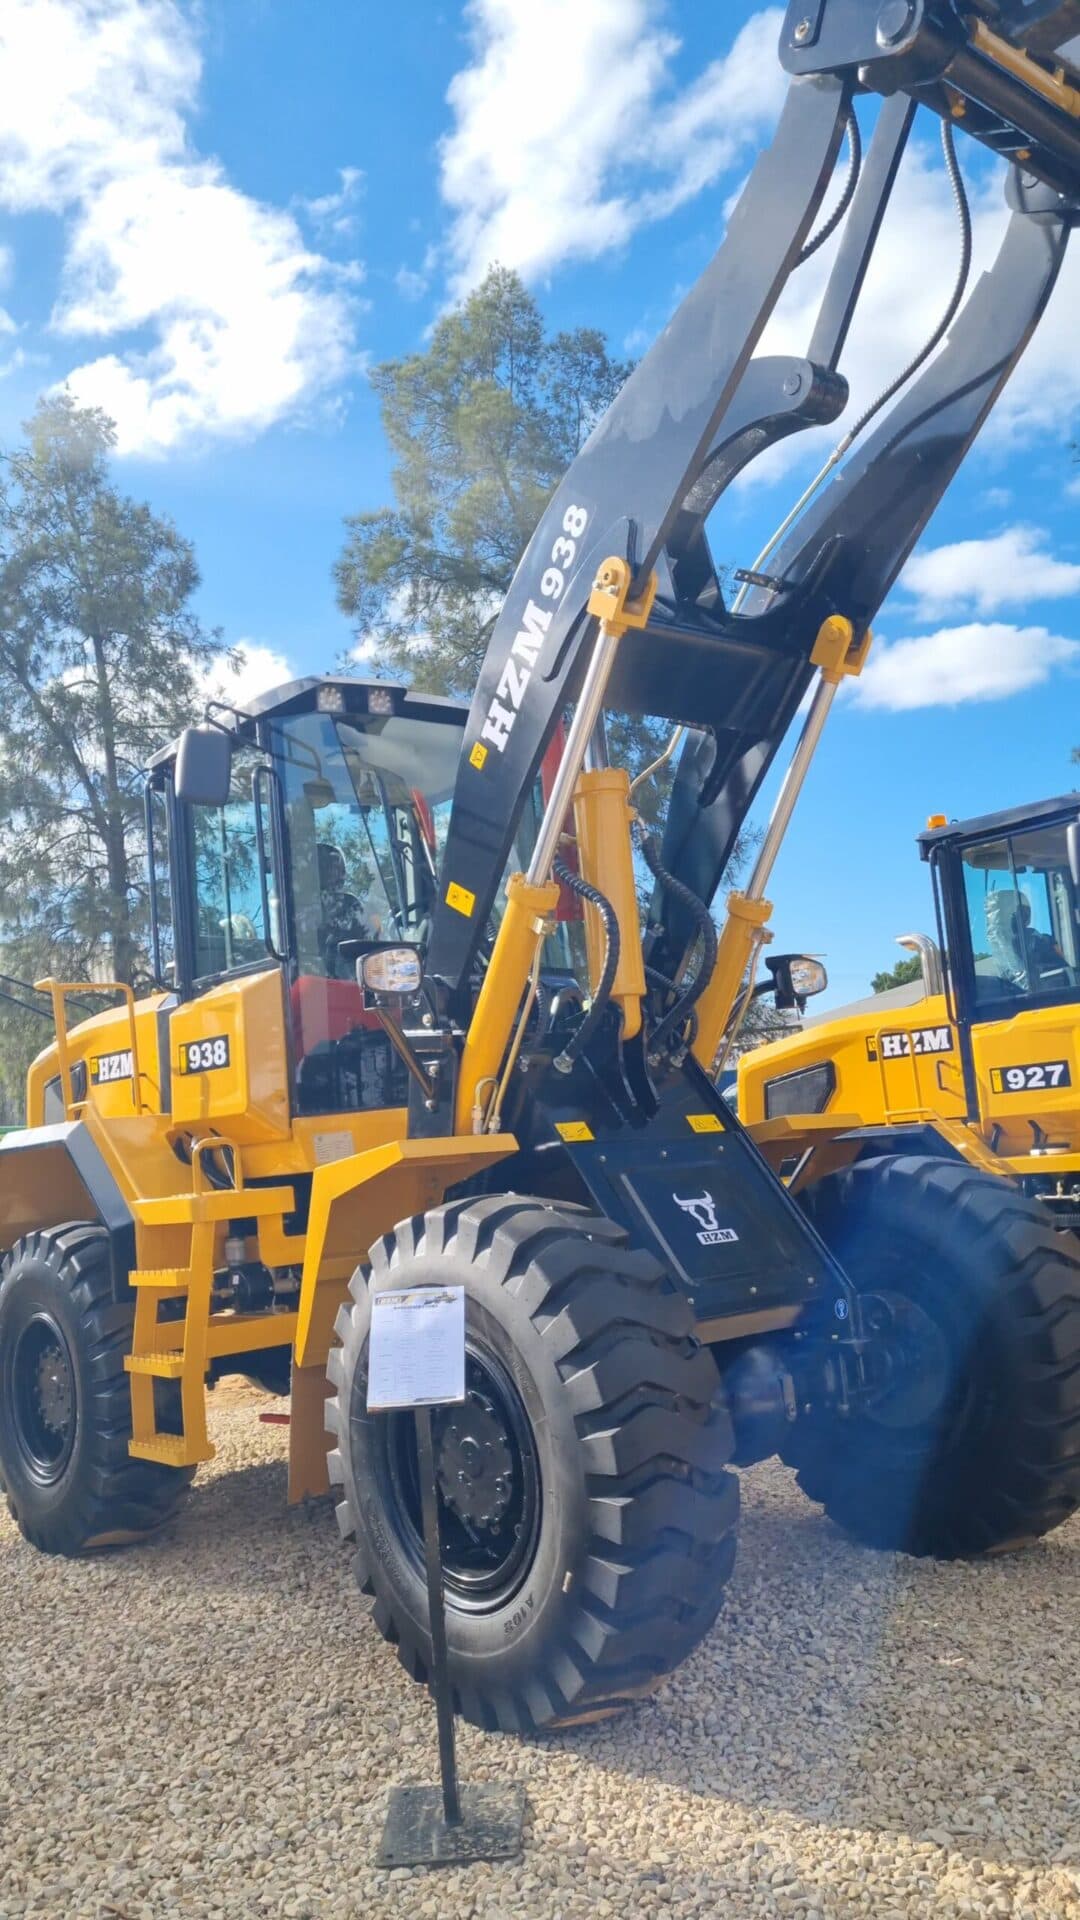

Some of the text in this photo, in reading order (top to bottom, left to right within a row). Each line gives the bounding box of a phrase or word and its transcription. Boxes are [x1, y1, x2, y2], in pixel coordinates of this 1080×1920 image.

[480, 504, 588, 752] HZM 938
[188, 1039, 227, 1070] 938
[881, 1027, 950, 1057] HZM
[98, 1051, 134, 1081] HZM
[1006, 1064, 1064, 1090] 927
[702, 1230, 734, 1244] HZM
